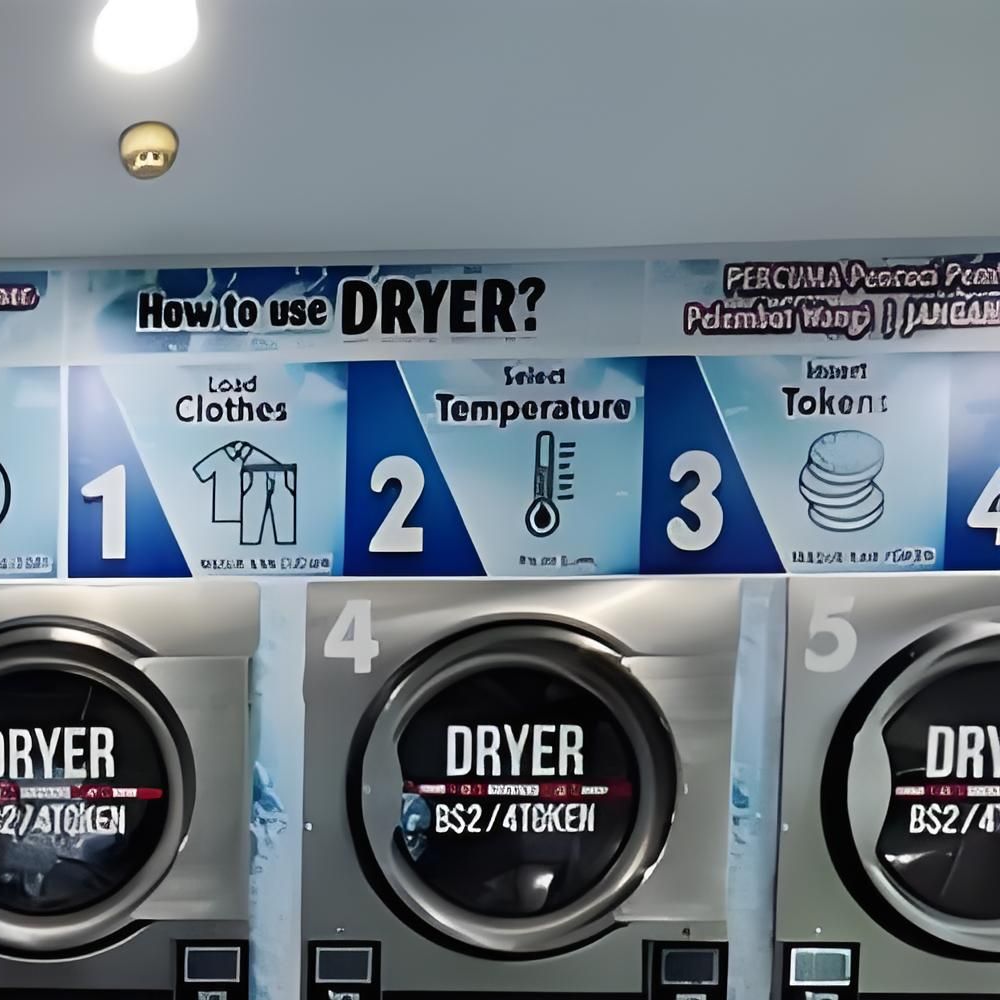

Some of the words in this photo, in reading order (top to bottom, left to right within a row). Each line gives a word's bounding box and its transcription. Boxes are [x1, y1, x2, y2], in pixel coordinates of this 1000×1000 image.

[139, 292, 214, 329] How
[224, 295, 258, 327] to
[270, 293, 327, 327] use
[341, 277, 547, 335] DRYER?
[176, 394, 288, 423] Clothes
[435, 393, 632, 429] Temperature
[81, 463, 126, 560] 1
[368, 455, 424, 553] 2
[666, 450, 724, 551] 3
[323, 599, 380, 674] 4
[804, 595, 858, 673] 5
[446, 724, 585, 777] DRYER
